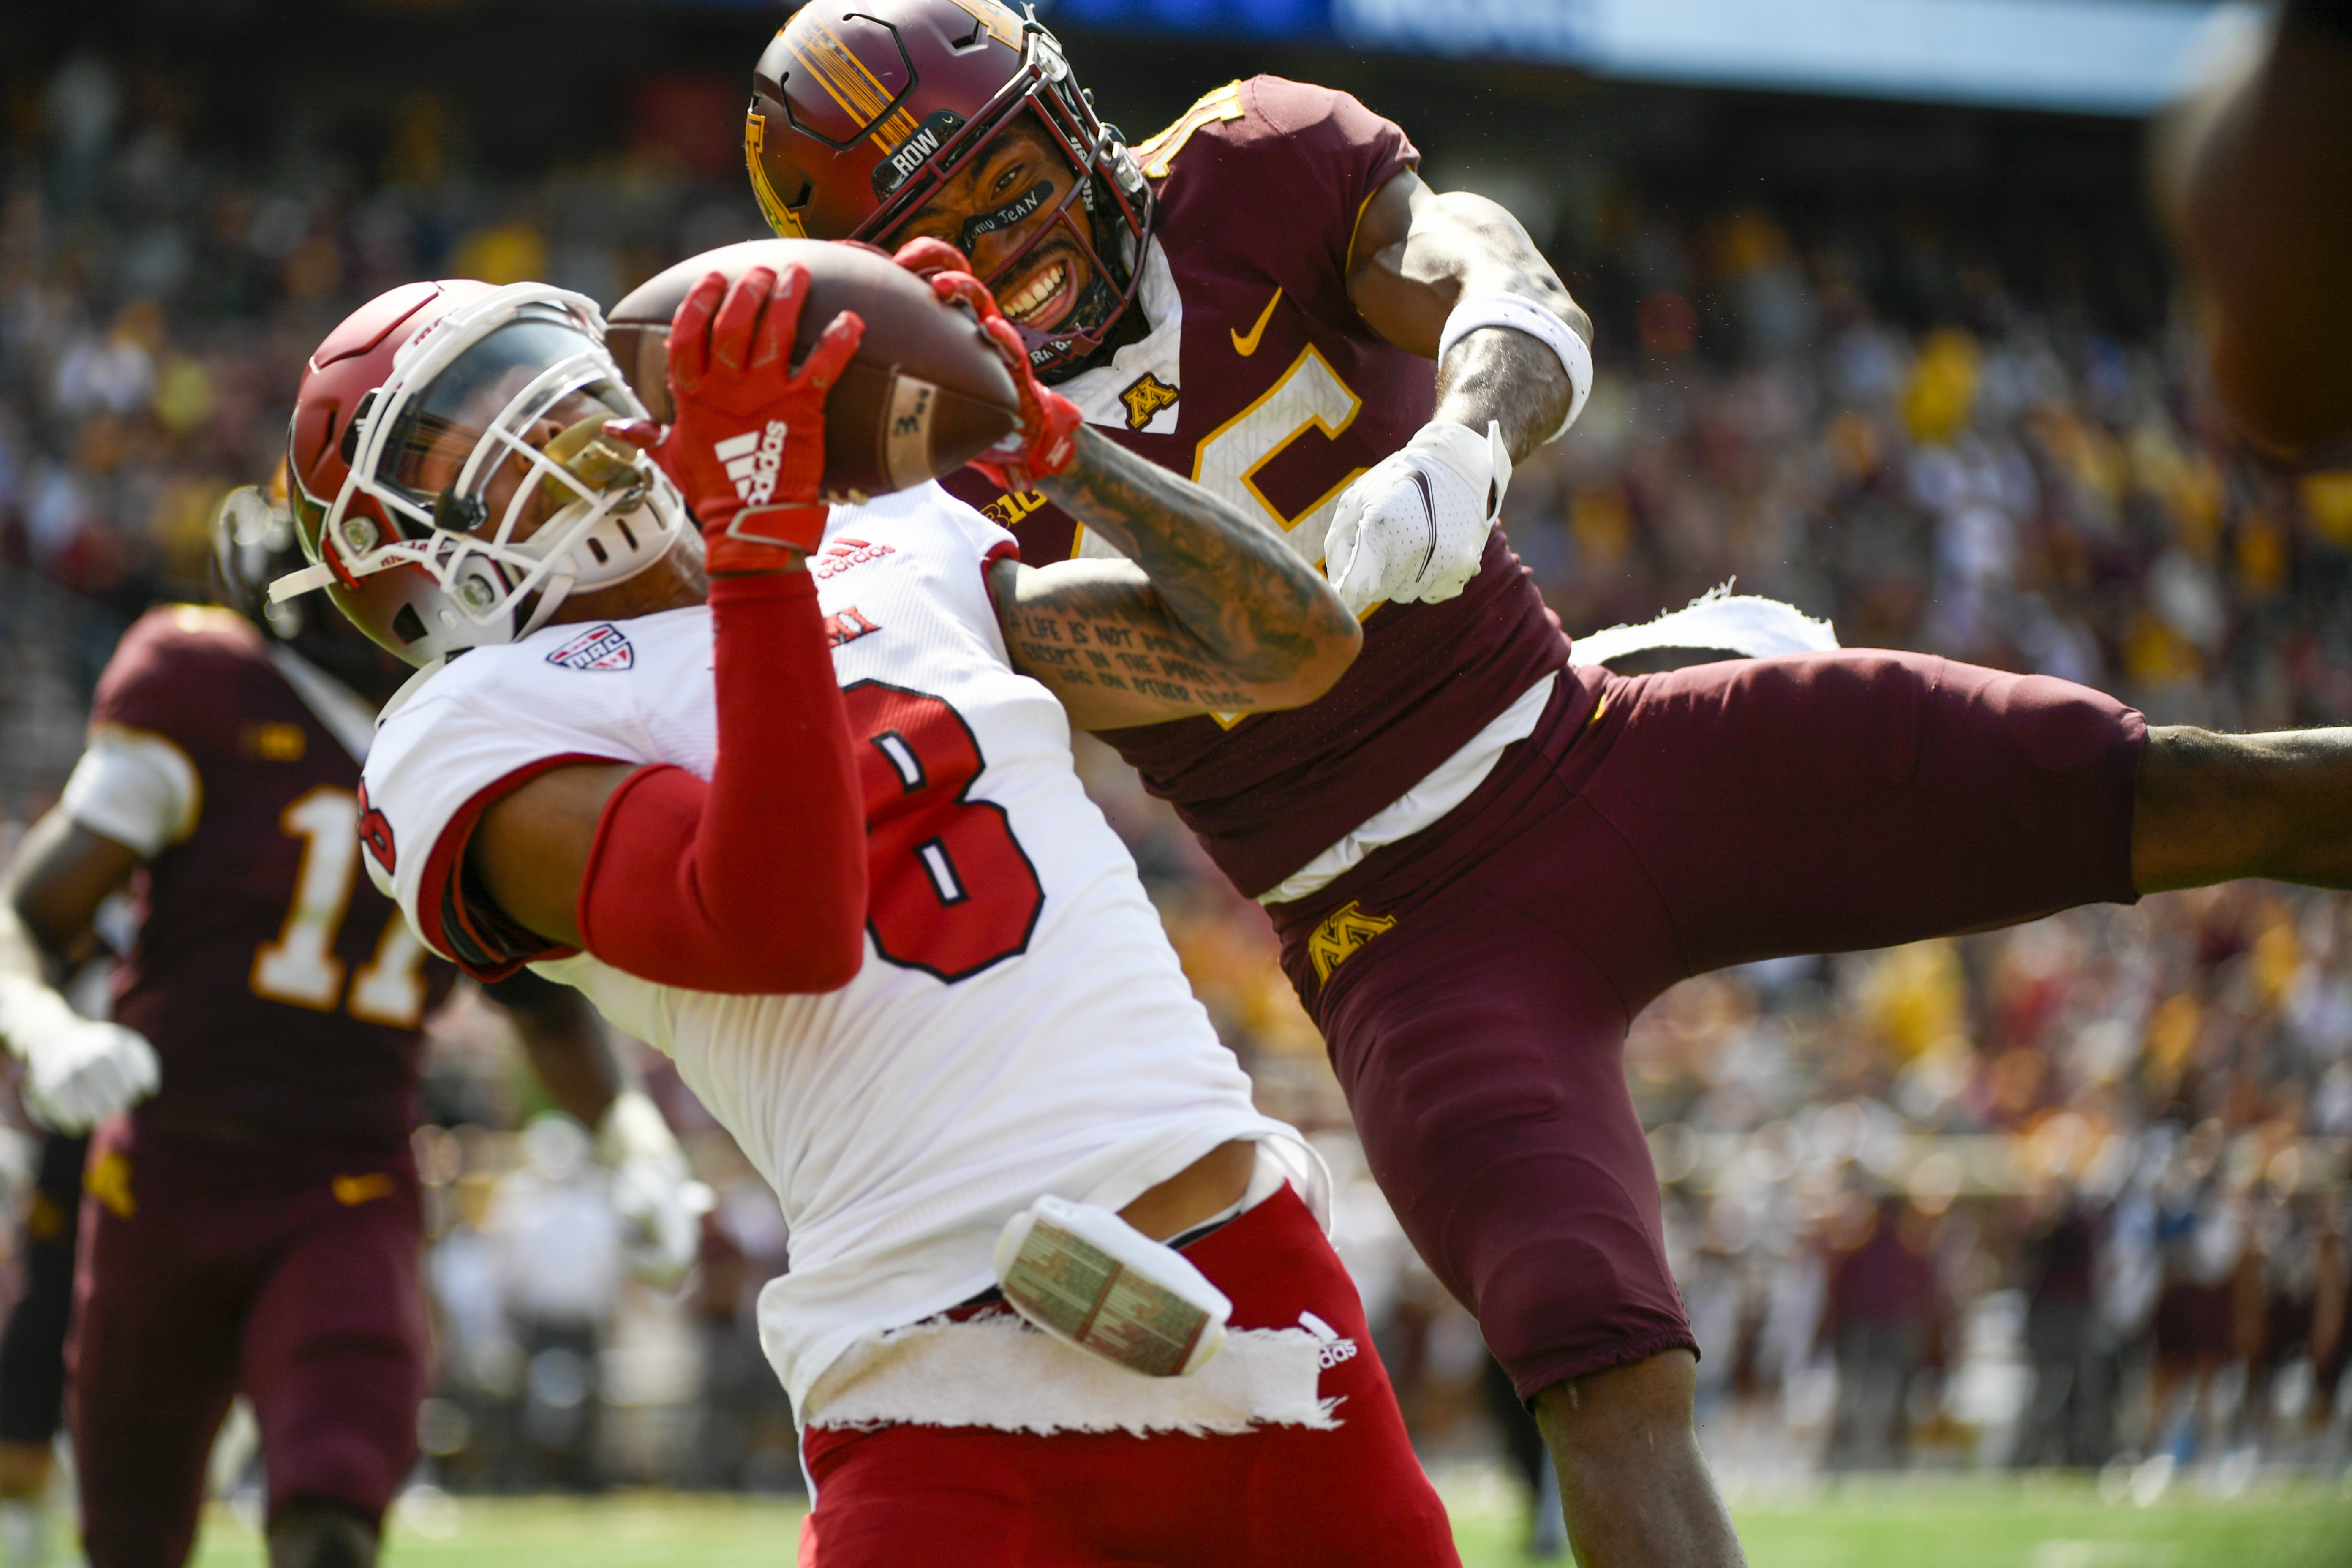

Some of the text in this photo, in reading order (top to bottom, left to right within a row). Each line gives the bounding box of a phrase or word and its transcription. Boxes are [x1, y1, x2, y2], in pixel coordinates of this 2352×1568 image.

[891, 128, 940, 177] ROW
[747, 419, 788, 506] adidas
[818, 545, 896, 579] adidas
[565, 632, 626, 670] MAC
[1025, 616, 1063, 641] LIFE
[1067, 620, 1089, 644] IS
[1094, 624, 1134, 648] NOT
[1116, 653, 1155, 673] THE
[842, 678, 1046, 985] 8
